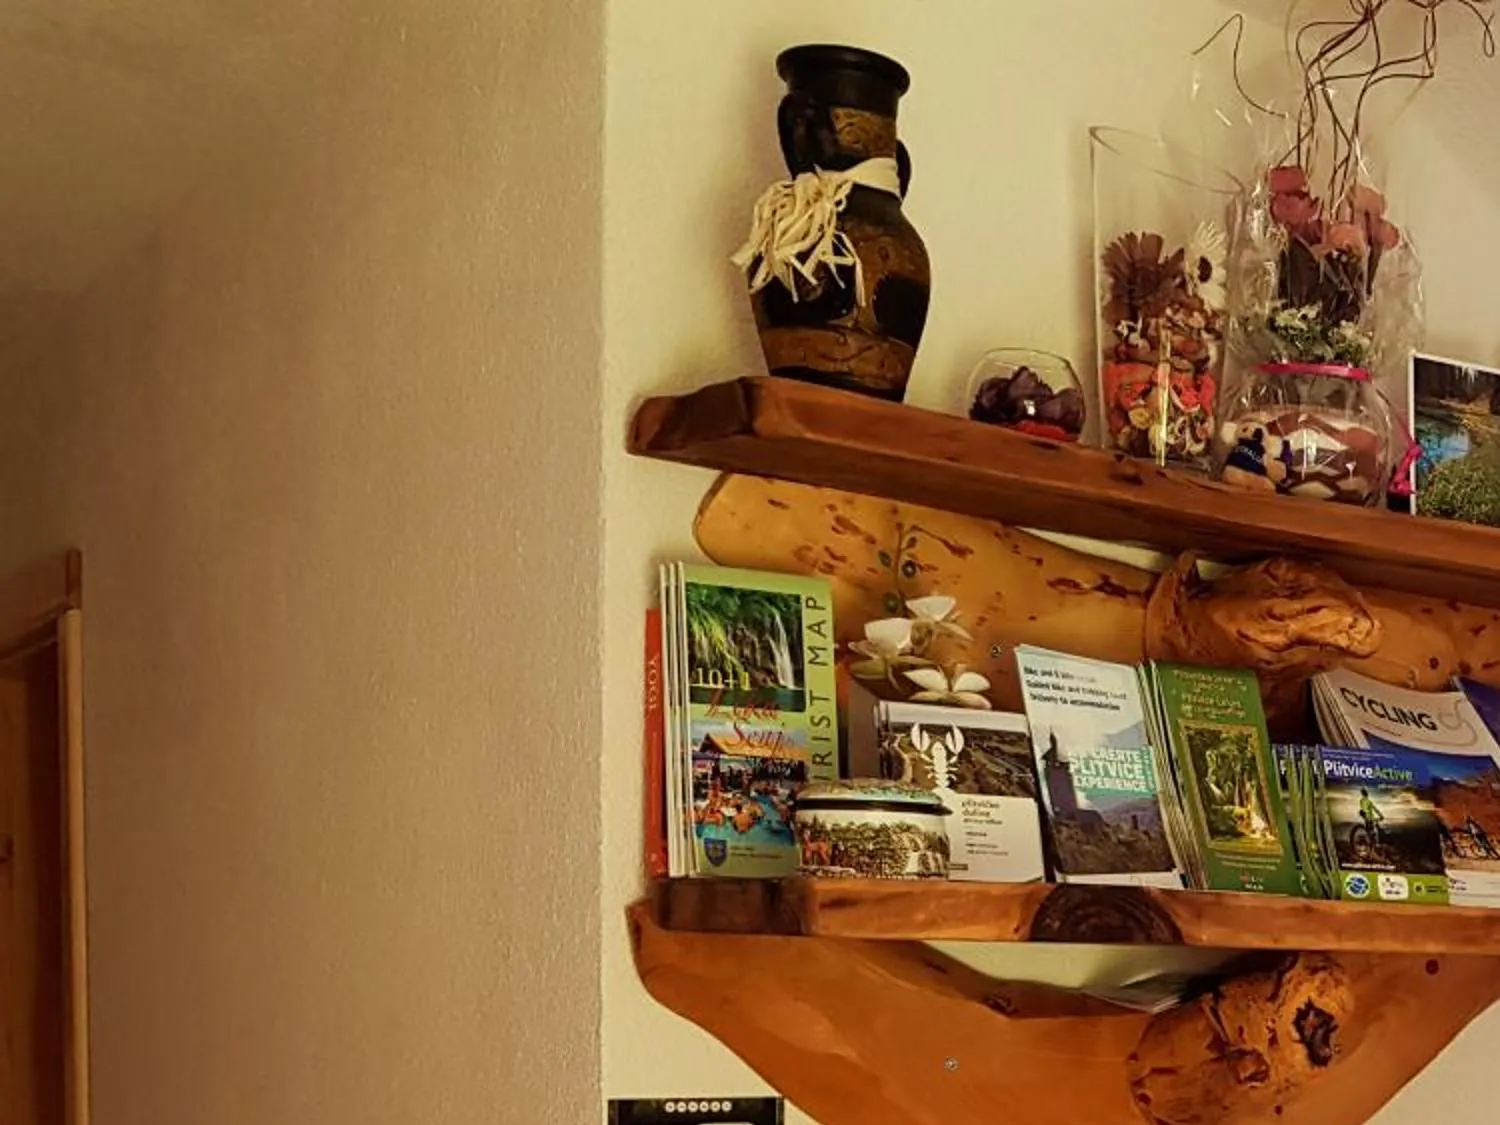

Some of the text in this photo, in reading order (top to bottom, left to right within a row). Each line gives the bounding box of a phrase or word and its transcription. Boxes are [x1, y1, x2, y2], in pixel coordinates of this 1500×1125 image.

[805, 596, 829, 667] MAP
[1340, 687, 1438, 731] CYCLING
[1069, 757, 1145, 780] PLITVICE
